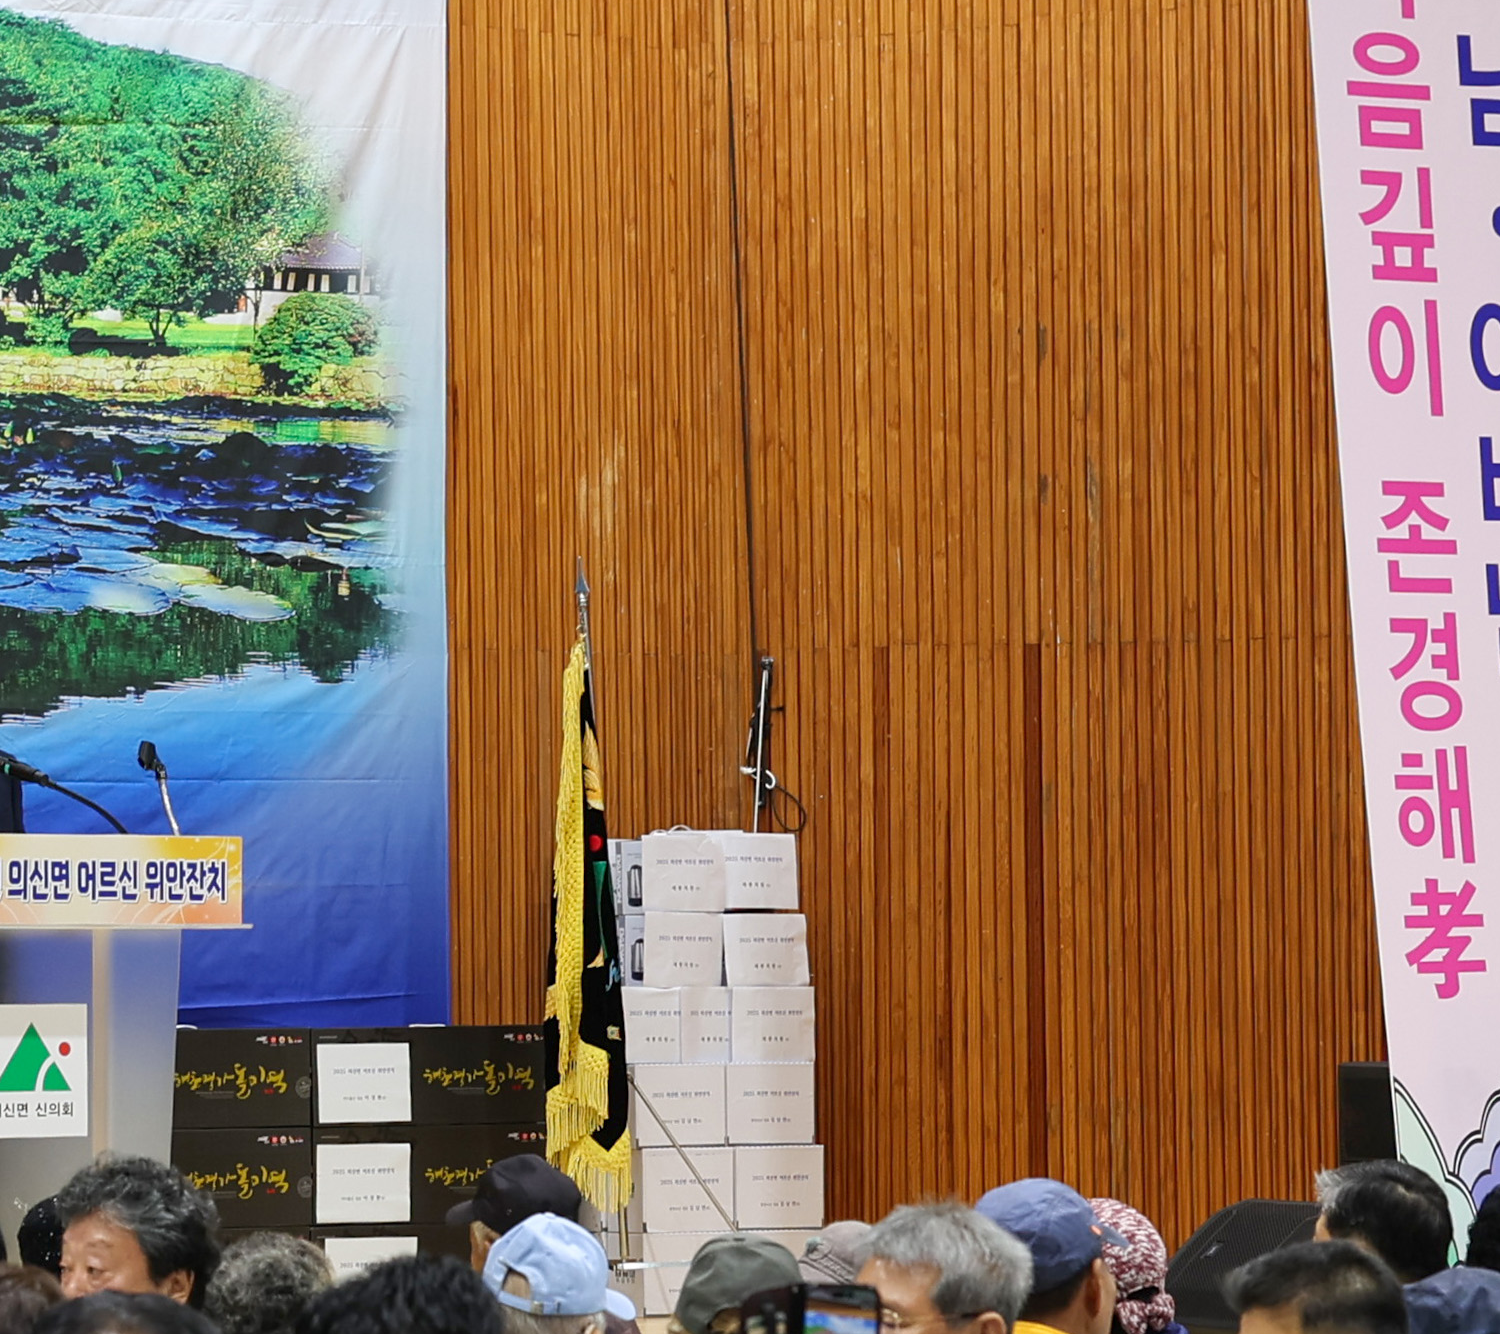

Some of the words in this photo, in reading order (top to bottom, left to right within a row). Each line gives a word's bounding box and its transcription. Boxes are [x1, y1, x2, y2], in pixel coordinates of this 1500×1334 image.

[8, 858, 72, 902] 의신면
[77, 858, 140, 902] 어르신
[144, 859, 228, 903] 위안잔치
[34, 1101, 75, 1118] 신의회
